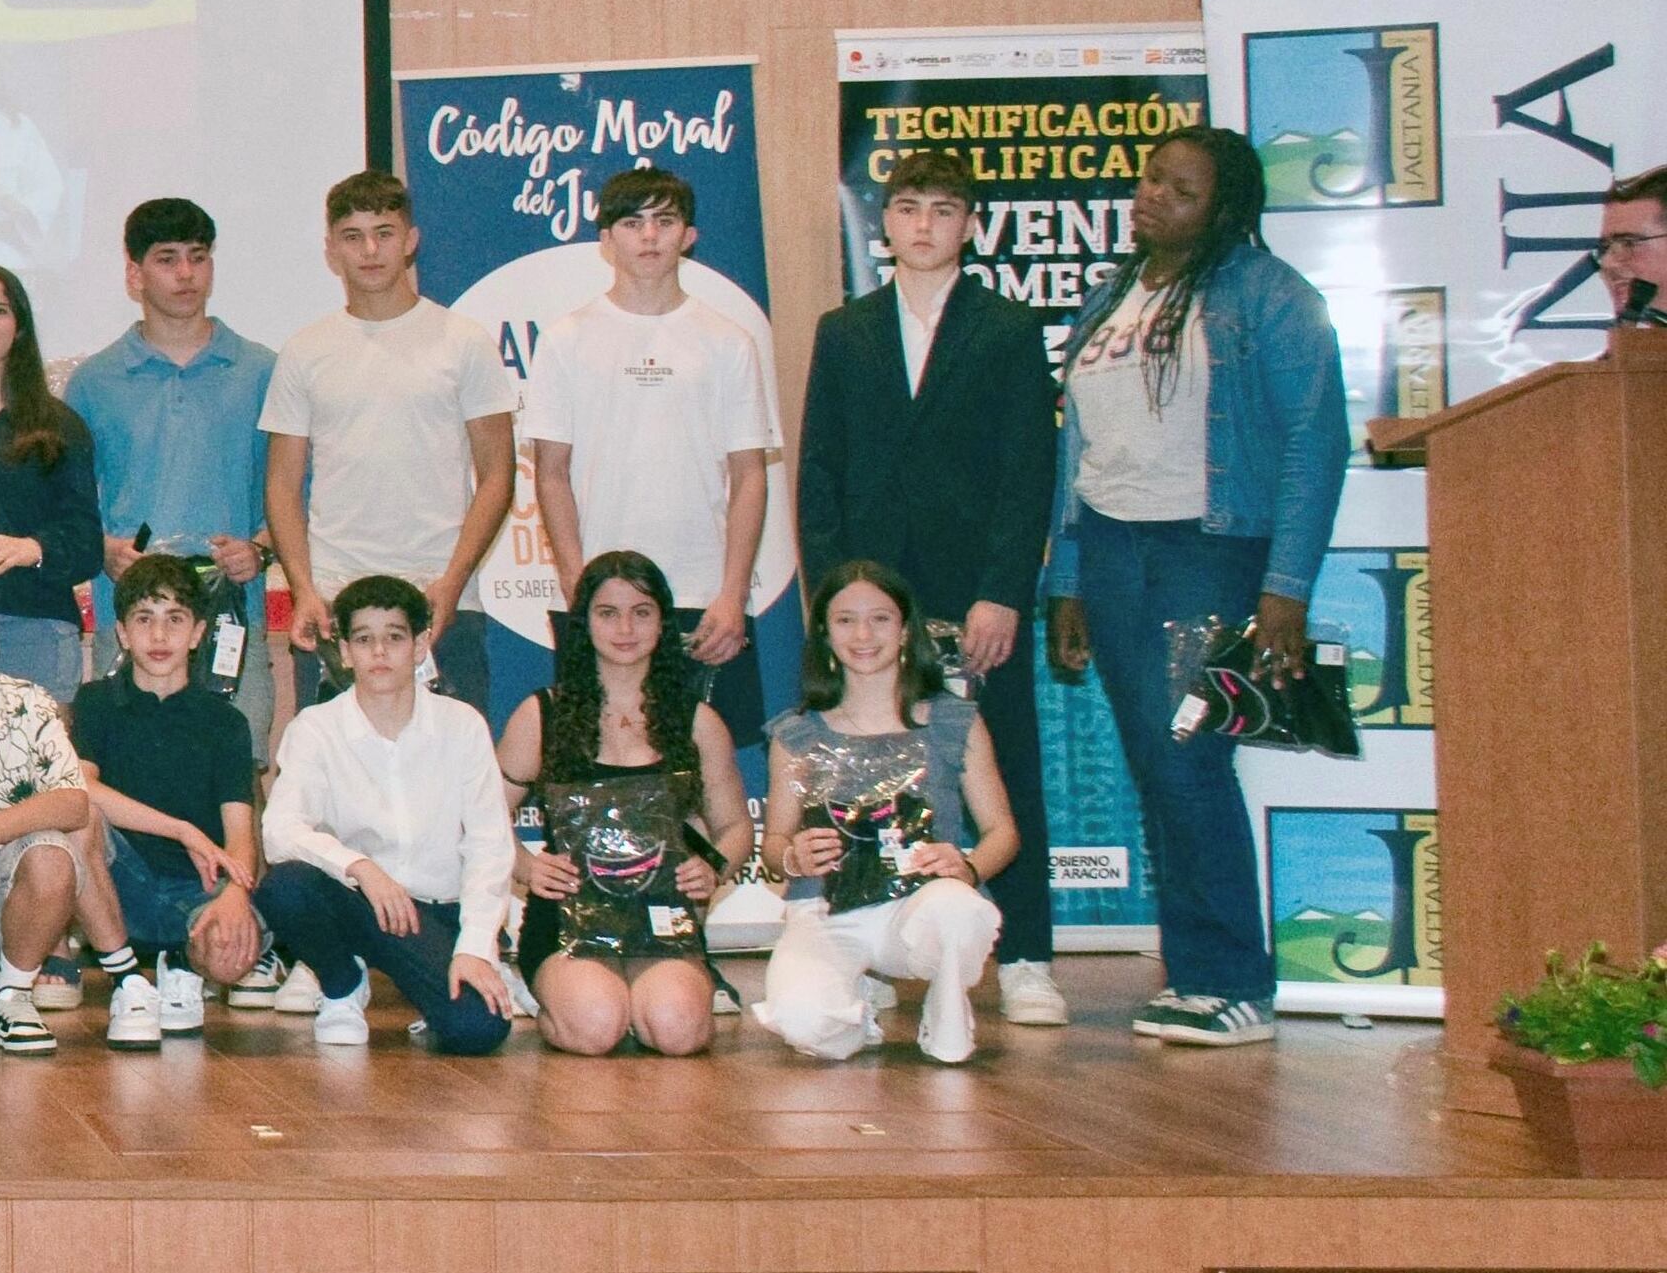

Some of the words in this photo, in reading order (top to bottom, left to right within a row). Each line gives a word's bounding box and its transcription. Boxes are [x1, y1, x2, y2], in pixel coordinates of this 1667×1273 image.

[428, 97, 584, 178] Código
[591, 89, 735, 155] Moral
[866, 93, 1202, 141] TECNIFICACIÓN
[1401, 53, 1425, 189] JACETANIA
[512, 179, 555, 215] del
[1492, 42, 1615, 360] NIA
[494, 580, 512, 599] ES
[1048, 855, 1110, 867] OBIERNO
